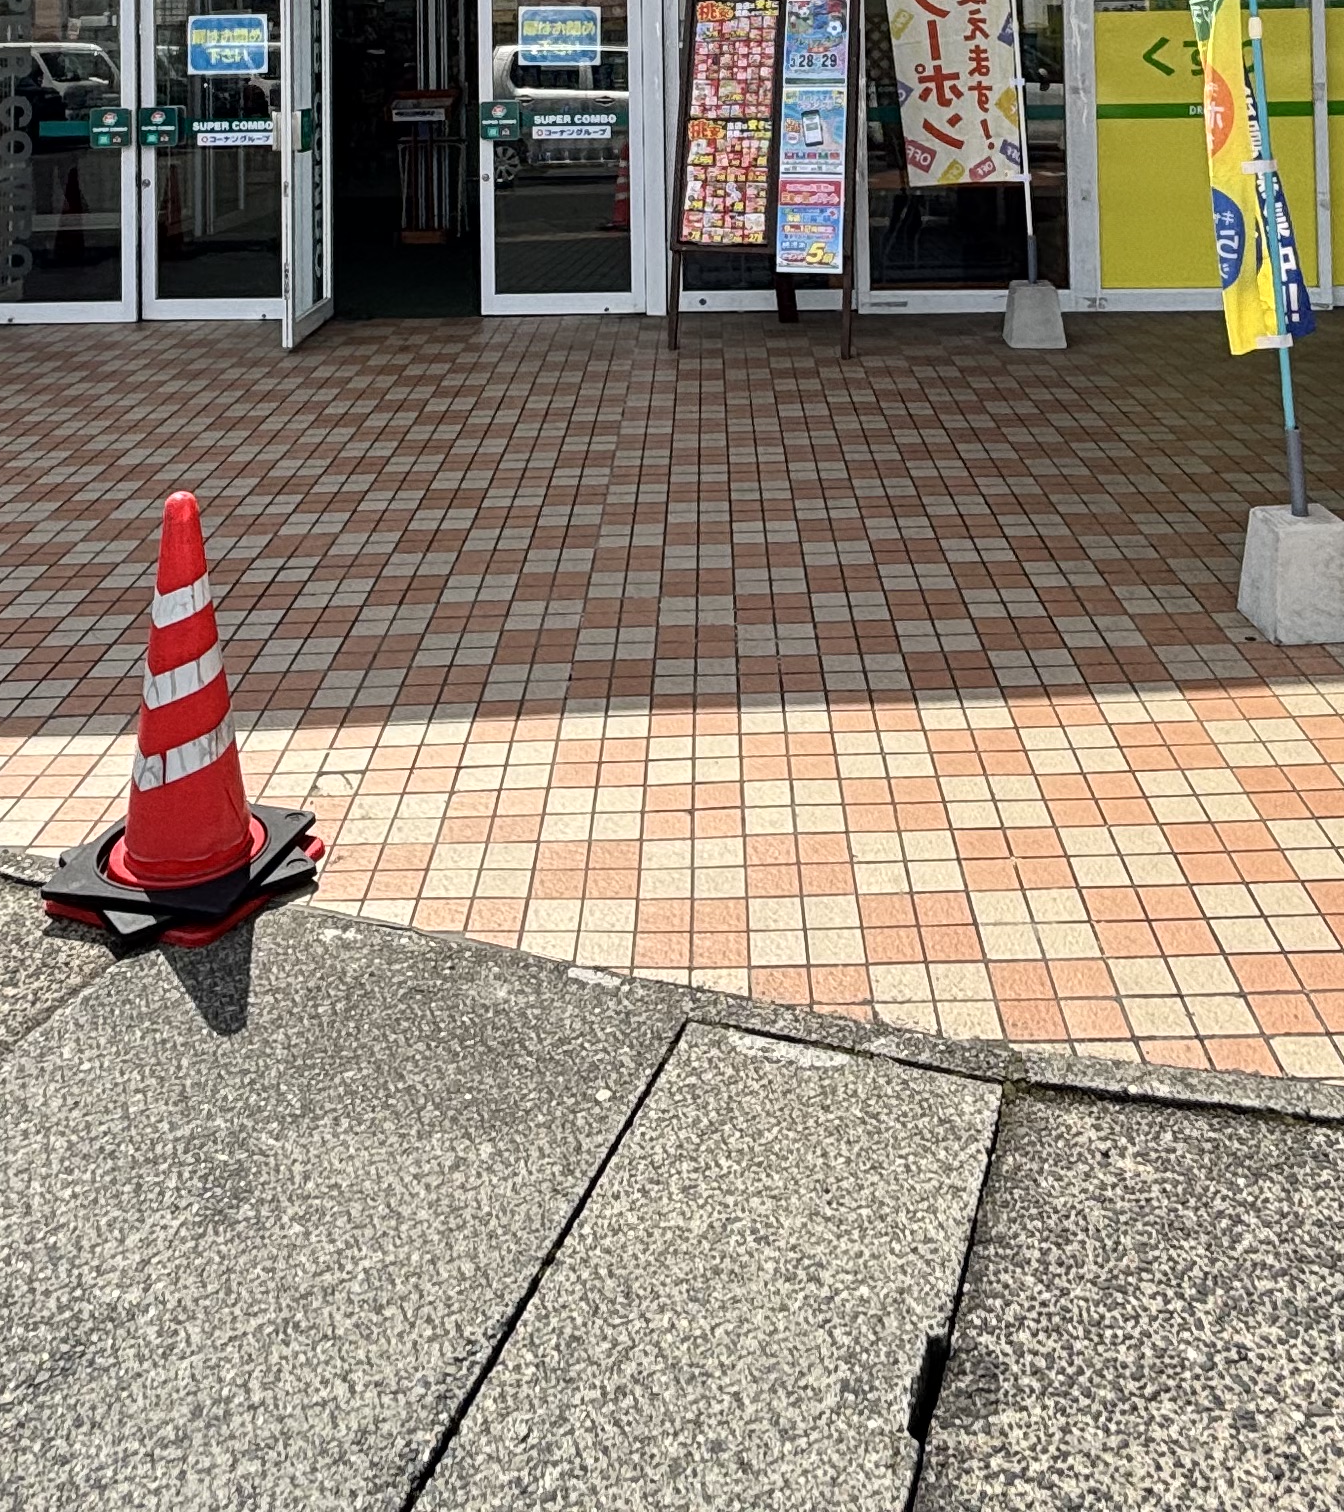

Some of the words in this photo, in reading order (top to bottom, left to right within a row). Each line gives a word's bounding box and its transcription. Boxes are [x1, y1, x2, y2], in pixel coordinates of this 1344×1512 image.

[798, 53, 814, 68] 28
[821, 53, 838, 68] 29
[533, 114, 572, 125] SUPER
[573, 113, 618, 124] COMBO
[192, 120, 230, 132] SUPER
[231, 119, 274, 131] COMBO
[544, 127, 608, 137] コーナングループ
[208, 134, 271, 144] コーナングループ
